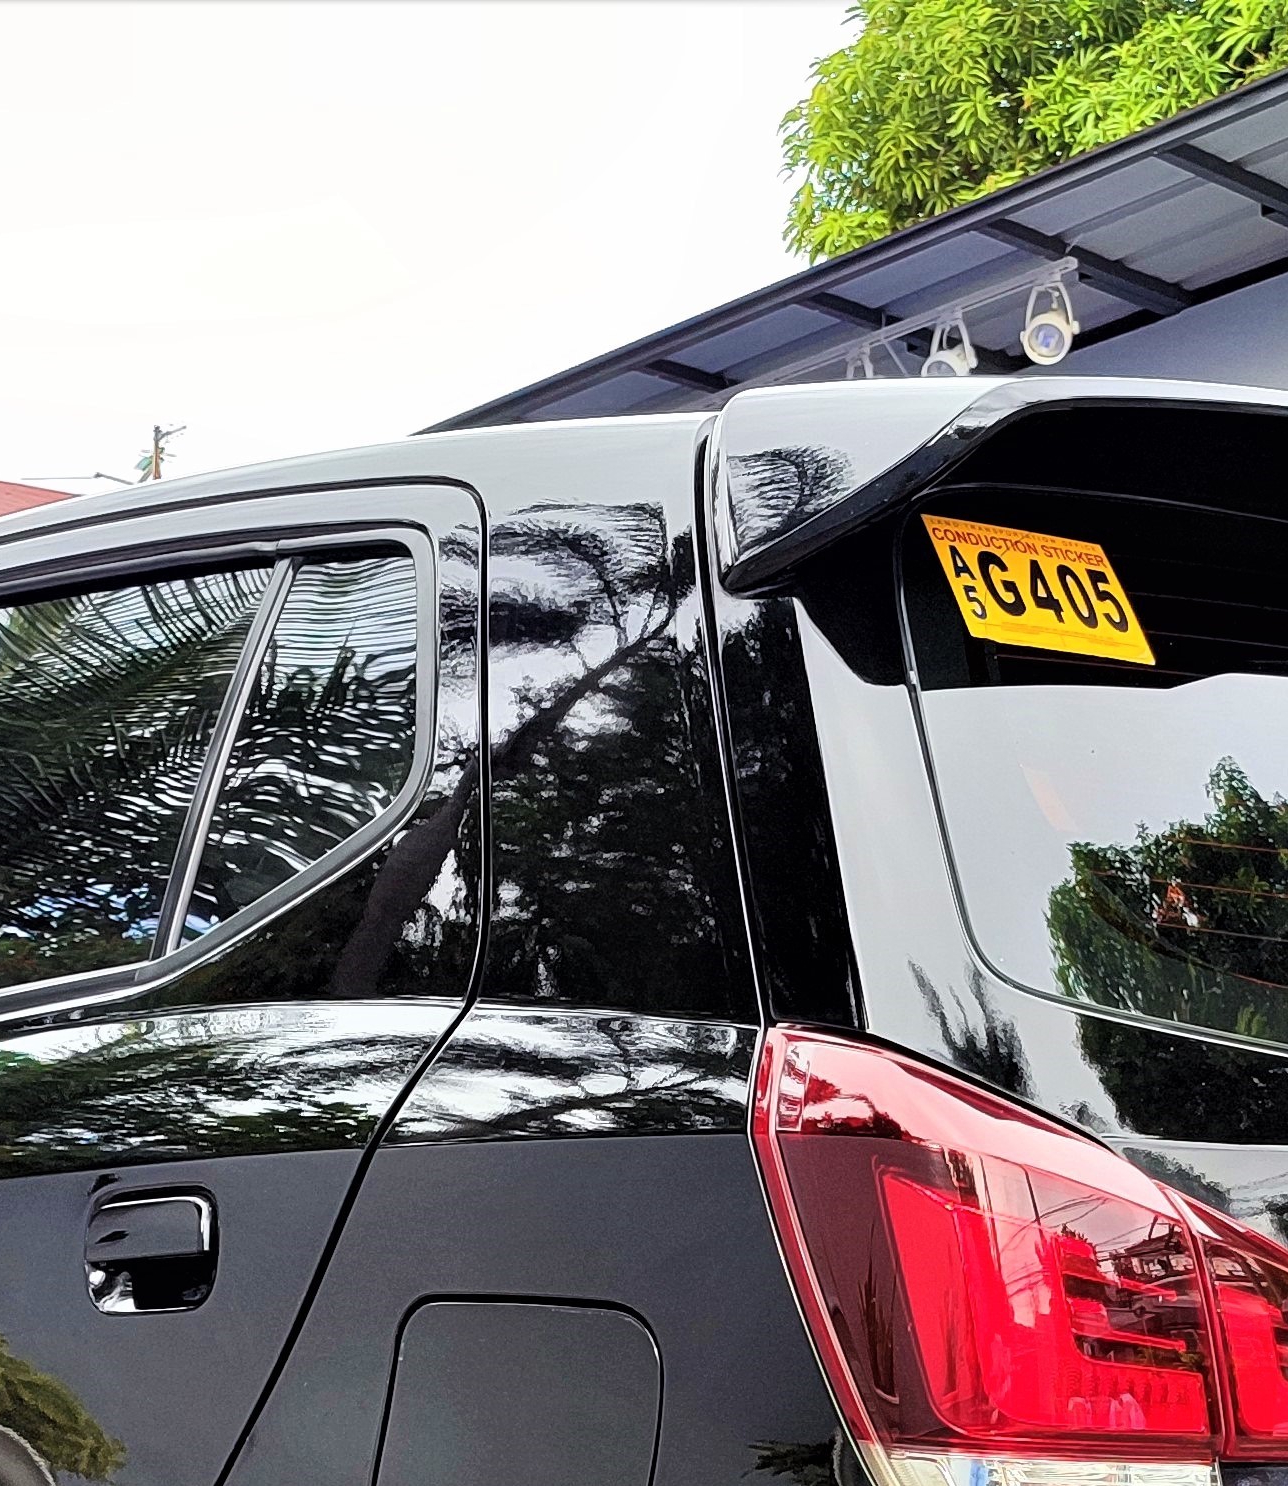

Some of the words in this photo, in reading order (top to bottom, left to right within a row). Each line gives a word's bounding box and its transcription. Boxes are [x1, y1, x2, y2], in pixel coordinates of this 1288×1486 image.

[931, 527, 1039, 556] CONDUCTION
[1043, 545, 1108, 569] STICKER
[948, 544, 977, 581] A
[963, 585, 988, 620] 5
[977, 550, 1129, 633] G405
